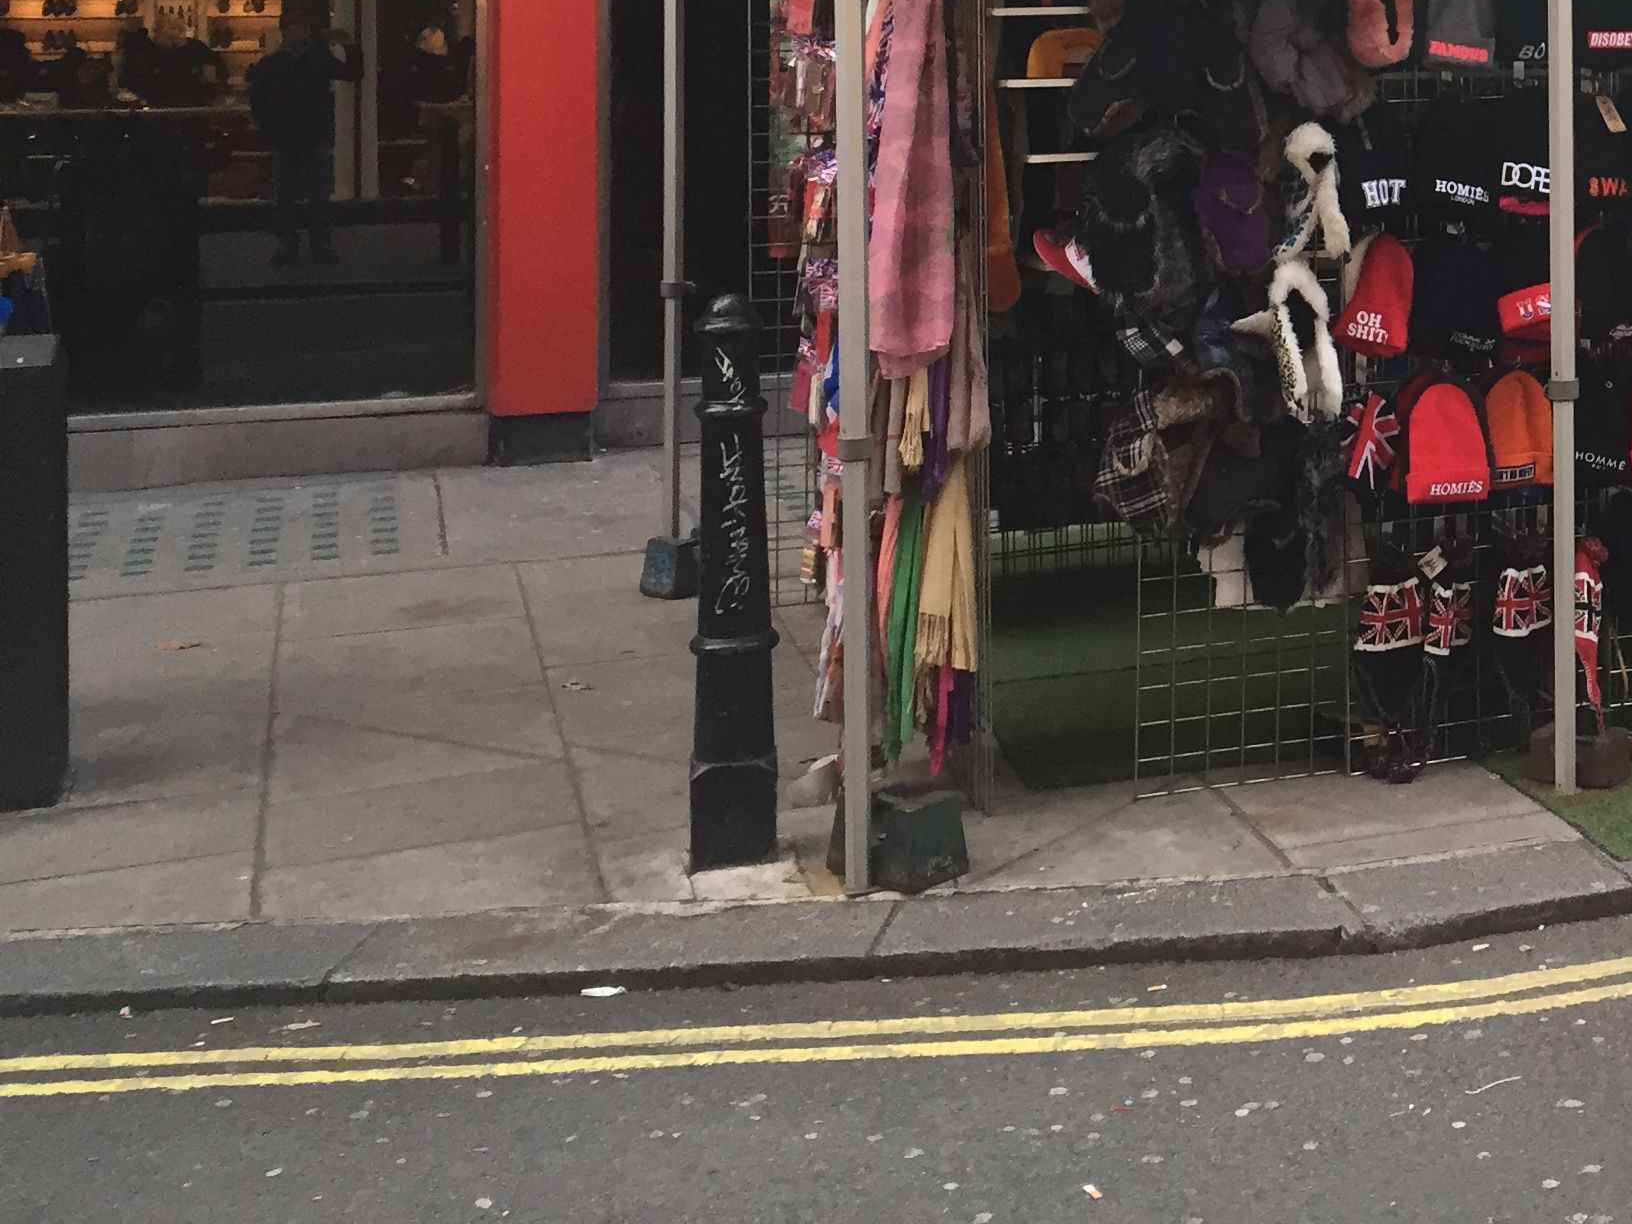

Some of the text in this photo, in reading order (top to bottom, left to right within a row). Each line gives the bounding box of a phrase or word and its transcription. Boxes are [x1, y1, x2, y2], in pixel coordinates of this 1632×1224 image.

[1519, 42, 1547, 60] BO
[1501, 162, 1550, 194] DOPE
[1589, 177, 1630, 197] SWA
[1362, 179, 1407, 209] HOT
[1435, 179, 1490, 203] HOMIES
[1516, 293, 1551, 320] US
[1356, 310, 1383, 328] OH
[1347, 322, 1388, 345] SHIT!
[1575, 450, 1627, 471] HOMME
[1429, 480, 1484, 497] HOMIES
